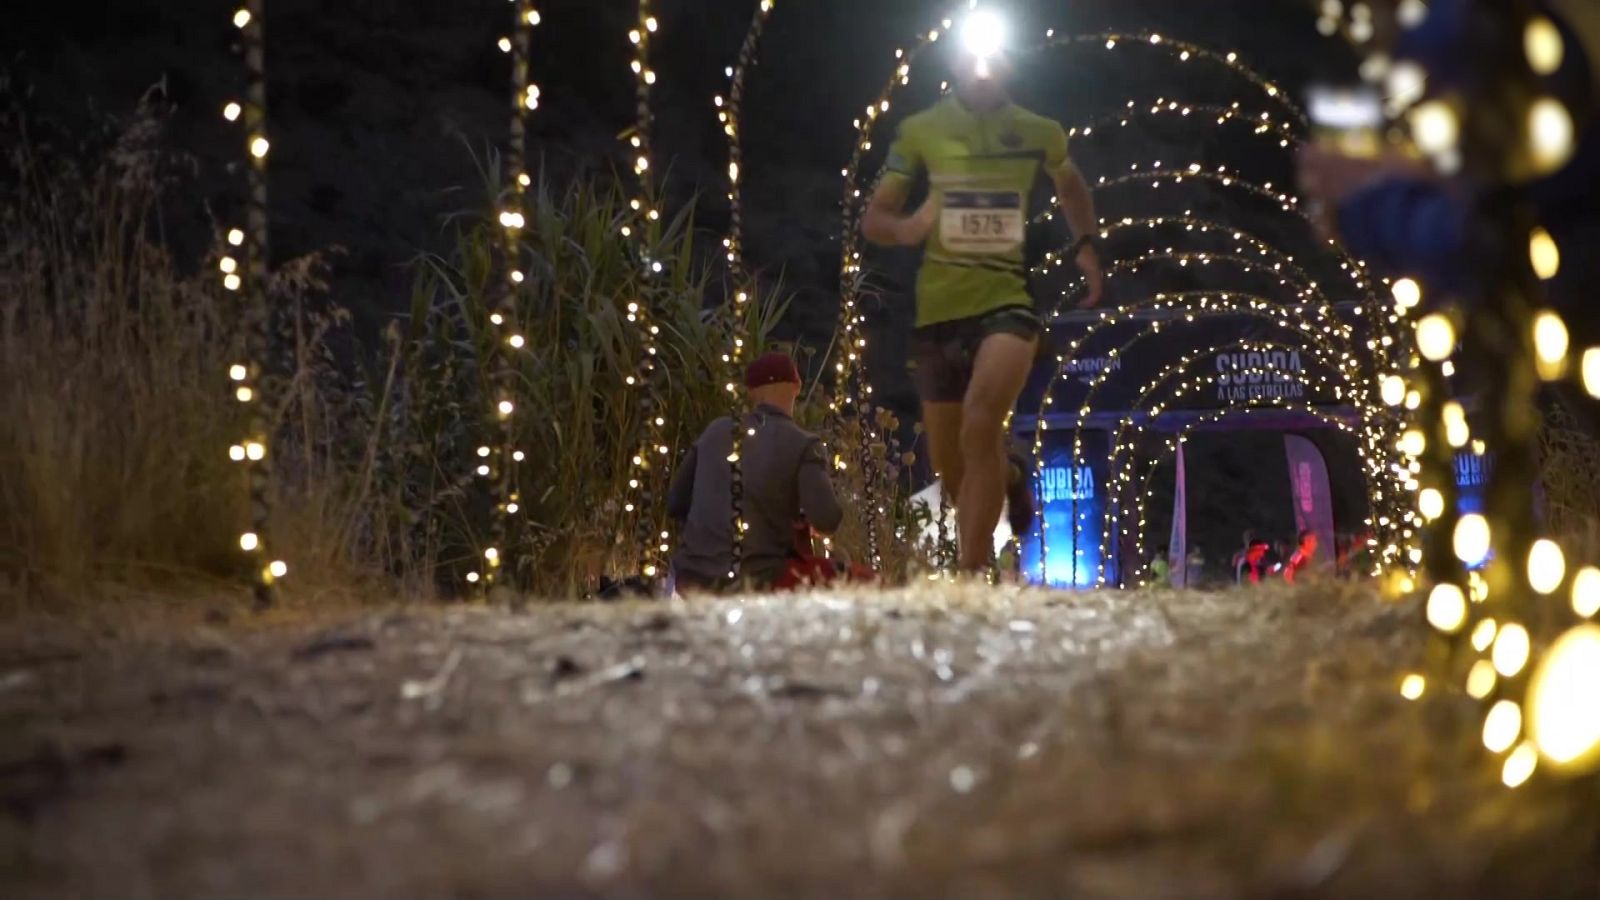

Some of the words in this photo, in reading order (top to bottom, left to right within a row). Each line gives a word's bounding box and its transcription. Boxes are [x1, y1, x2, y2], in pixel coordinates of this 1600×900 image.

[961, 213, 1004, 235] 1575
[1216, 351, 1302, 385] SUBIDA
[1217, 387, 1225, 400] A
[1227, 386, 1246, 400] LAS
[1248, 384, 1303, 400] ESTRELLAS
